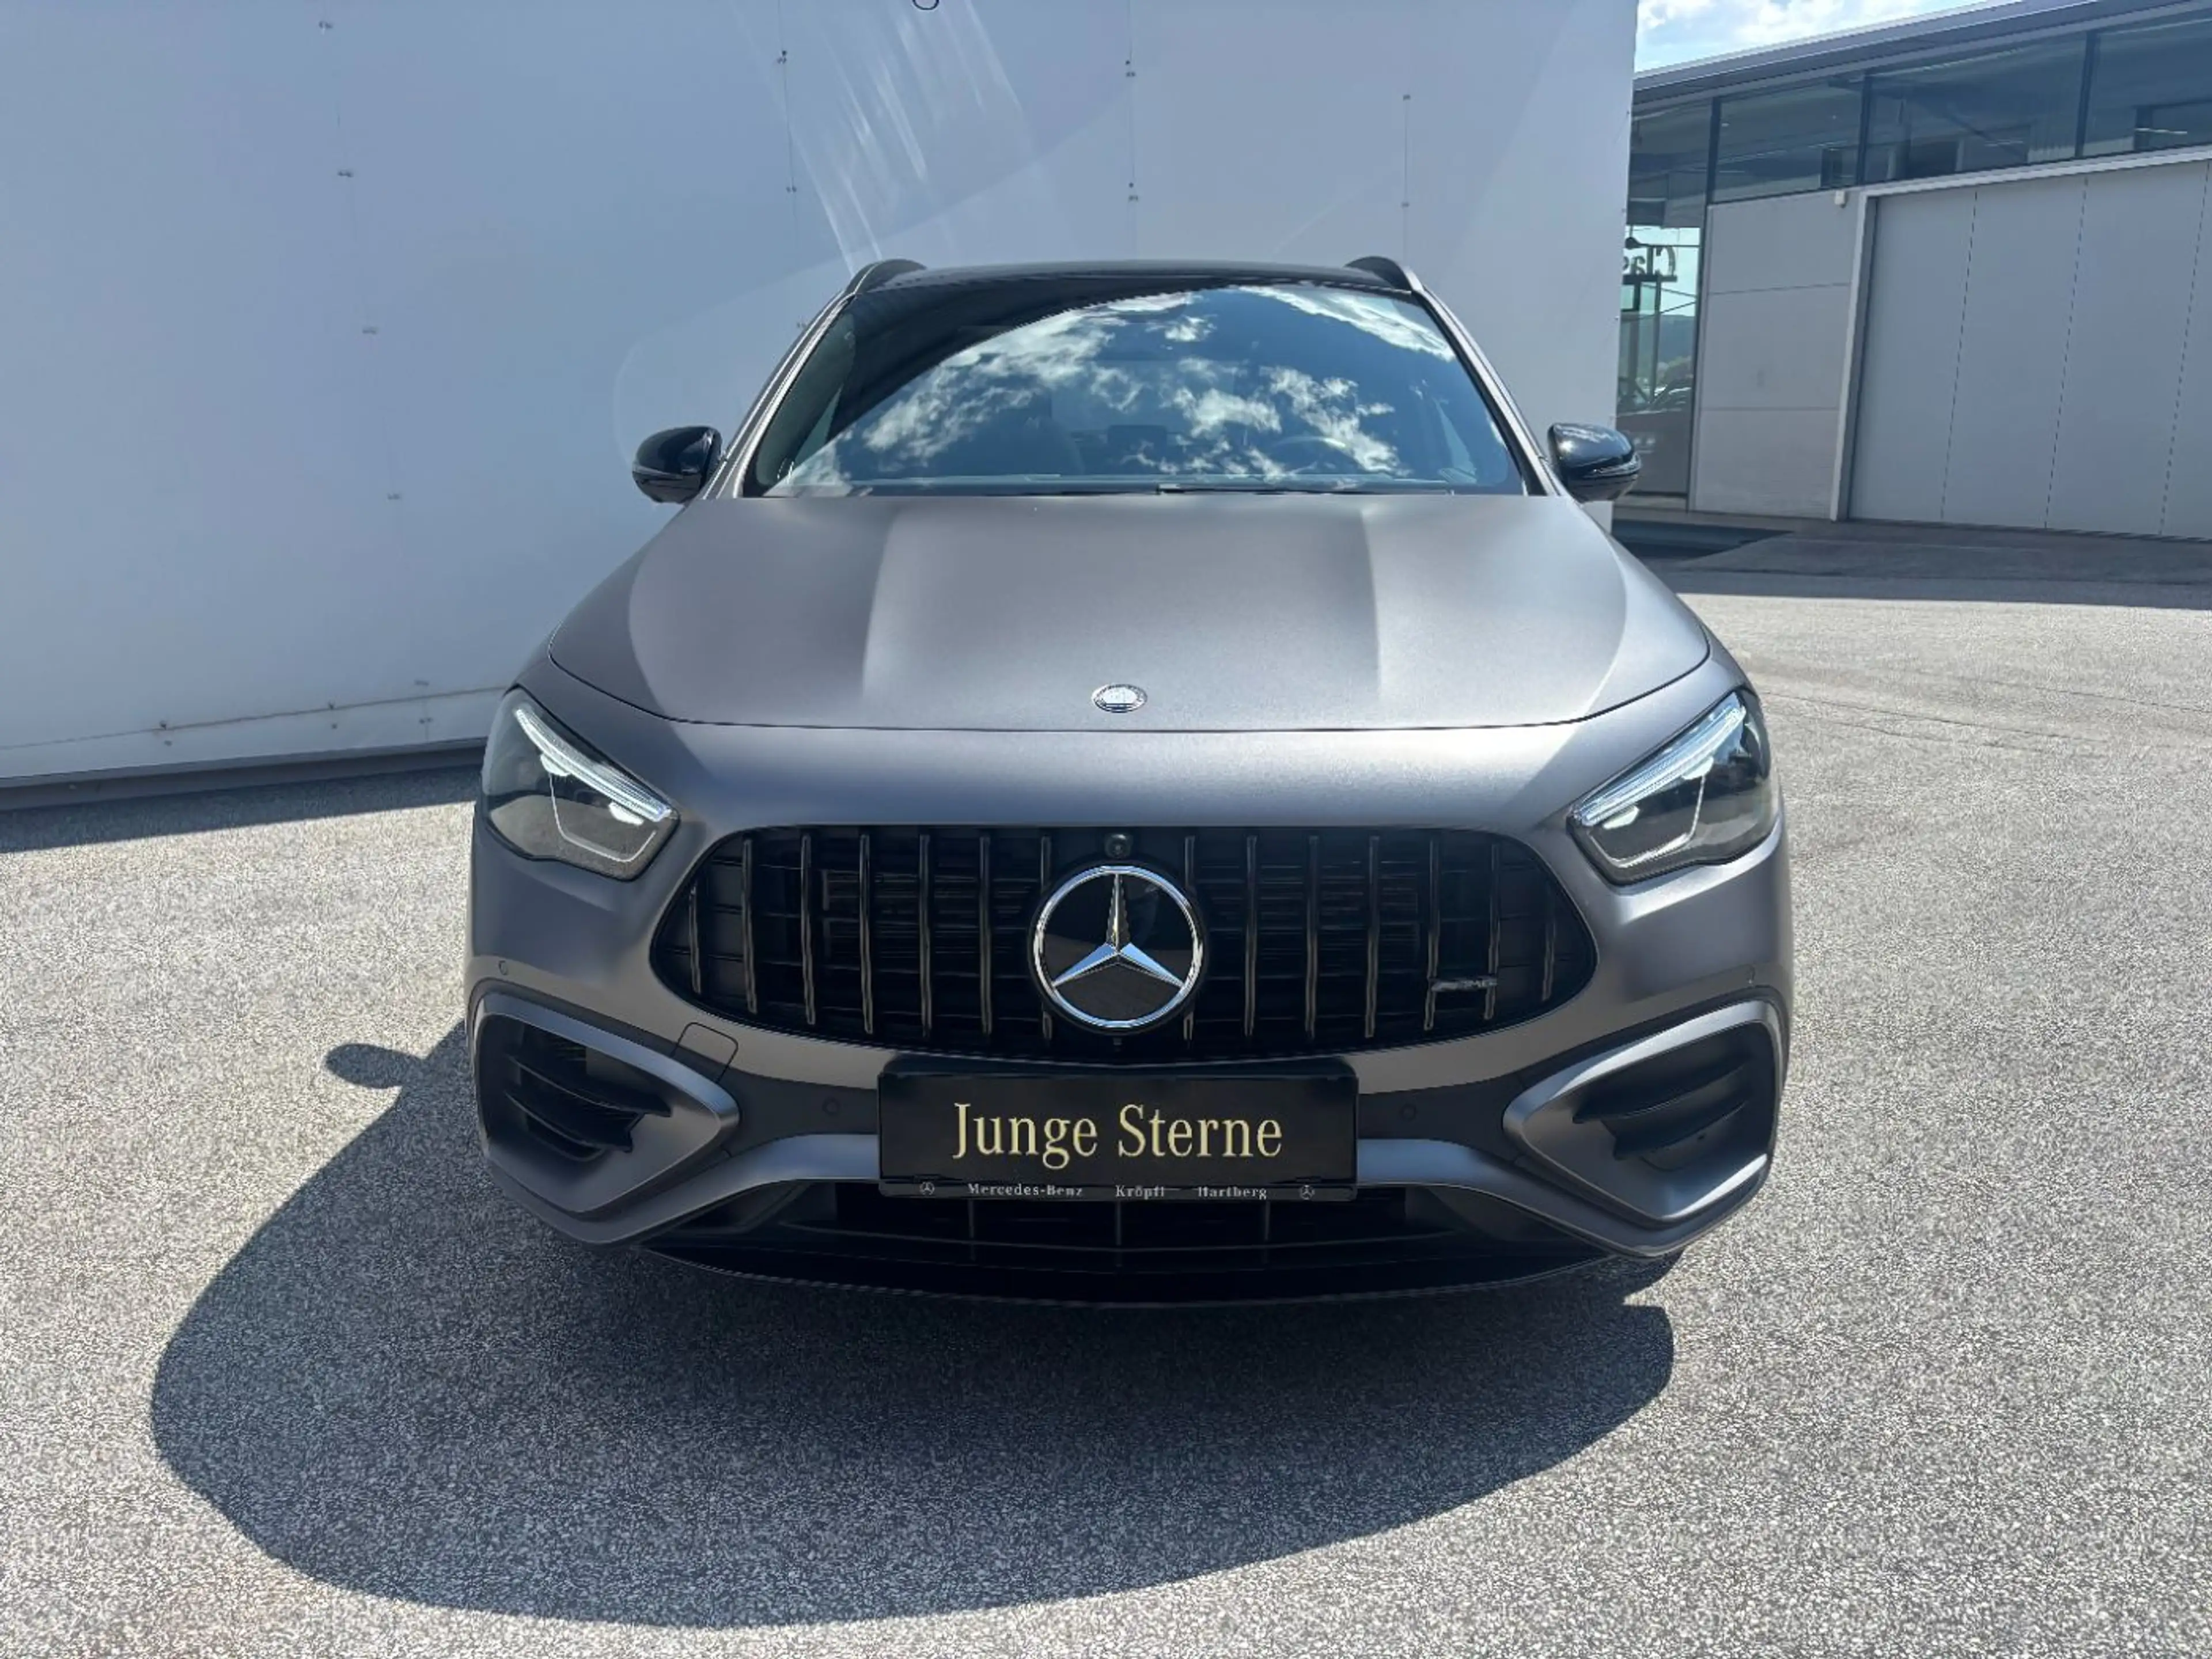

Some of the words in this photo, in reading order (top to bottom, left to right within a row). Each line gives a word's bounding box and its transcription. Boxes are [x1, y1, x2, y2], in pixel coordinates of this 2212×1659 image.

[953, 1103, 1097, 1169] Junge
[1118, 1104, 1282, 1157] Sterne
[968, 1183, 1083, 1196] Mercedes-Benz
